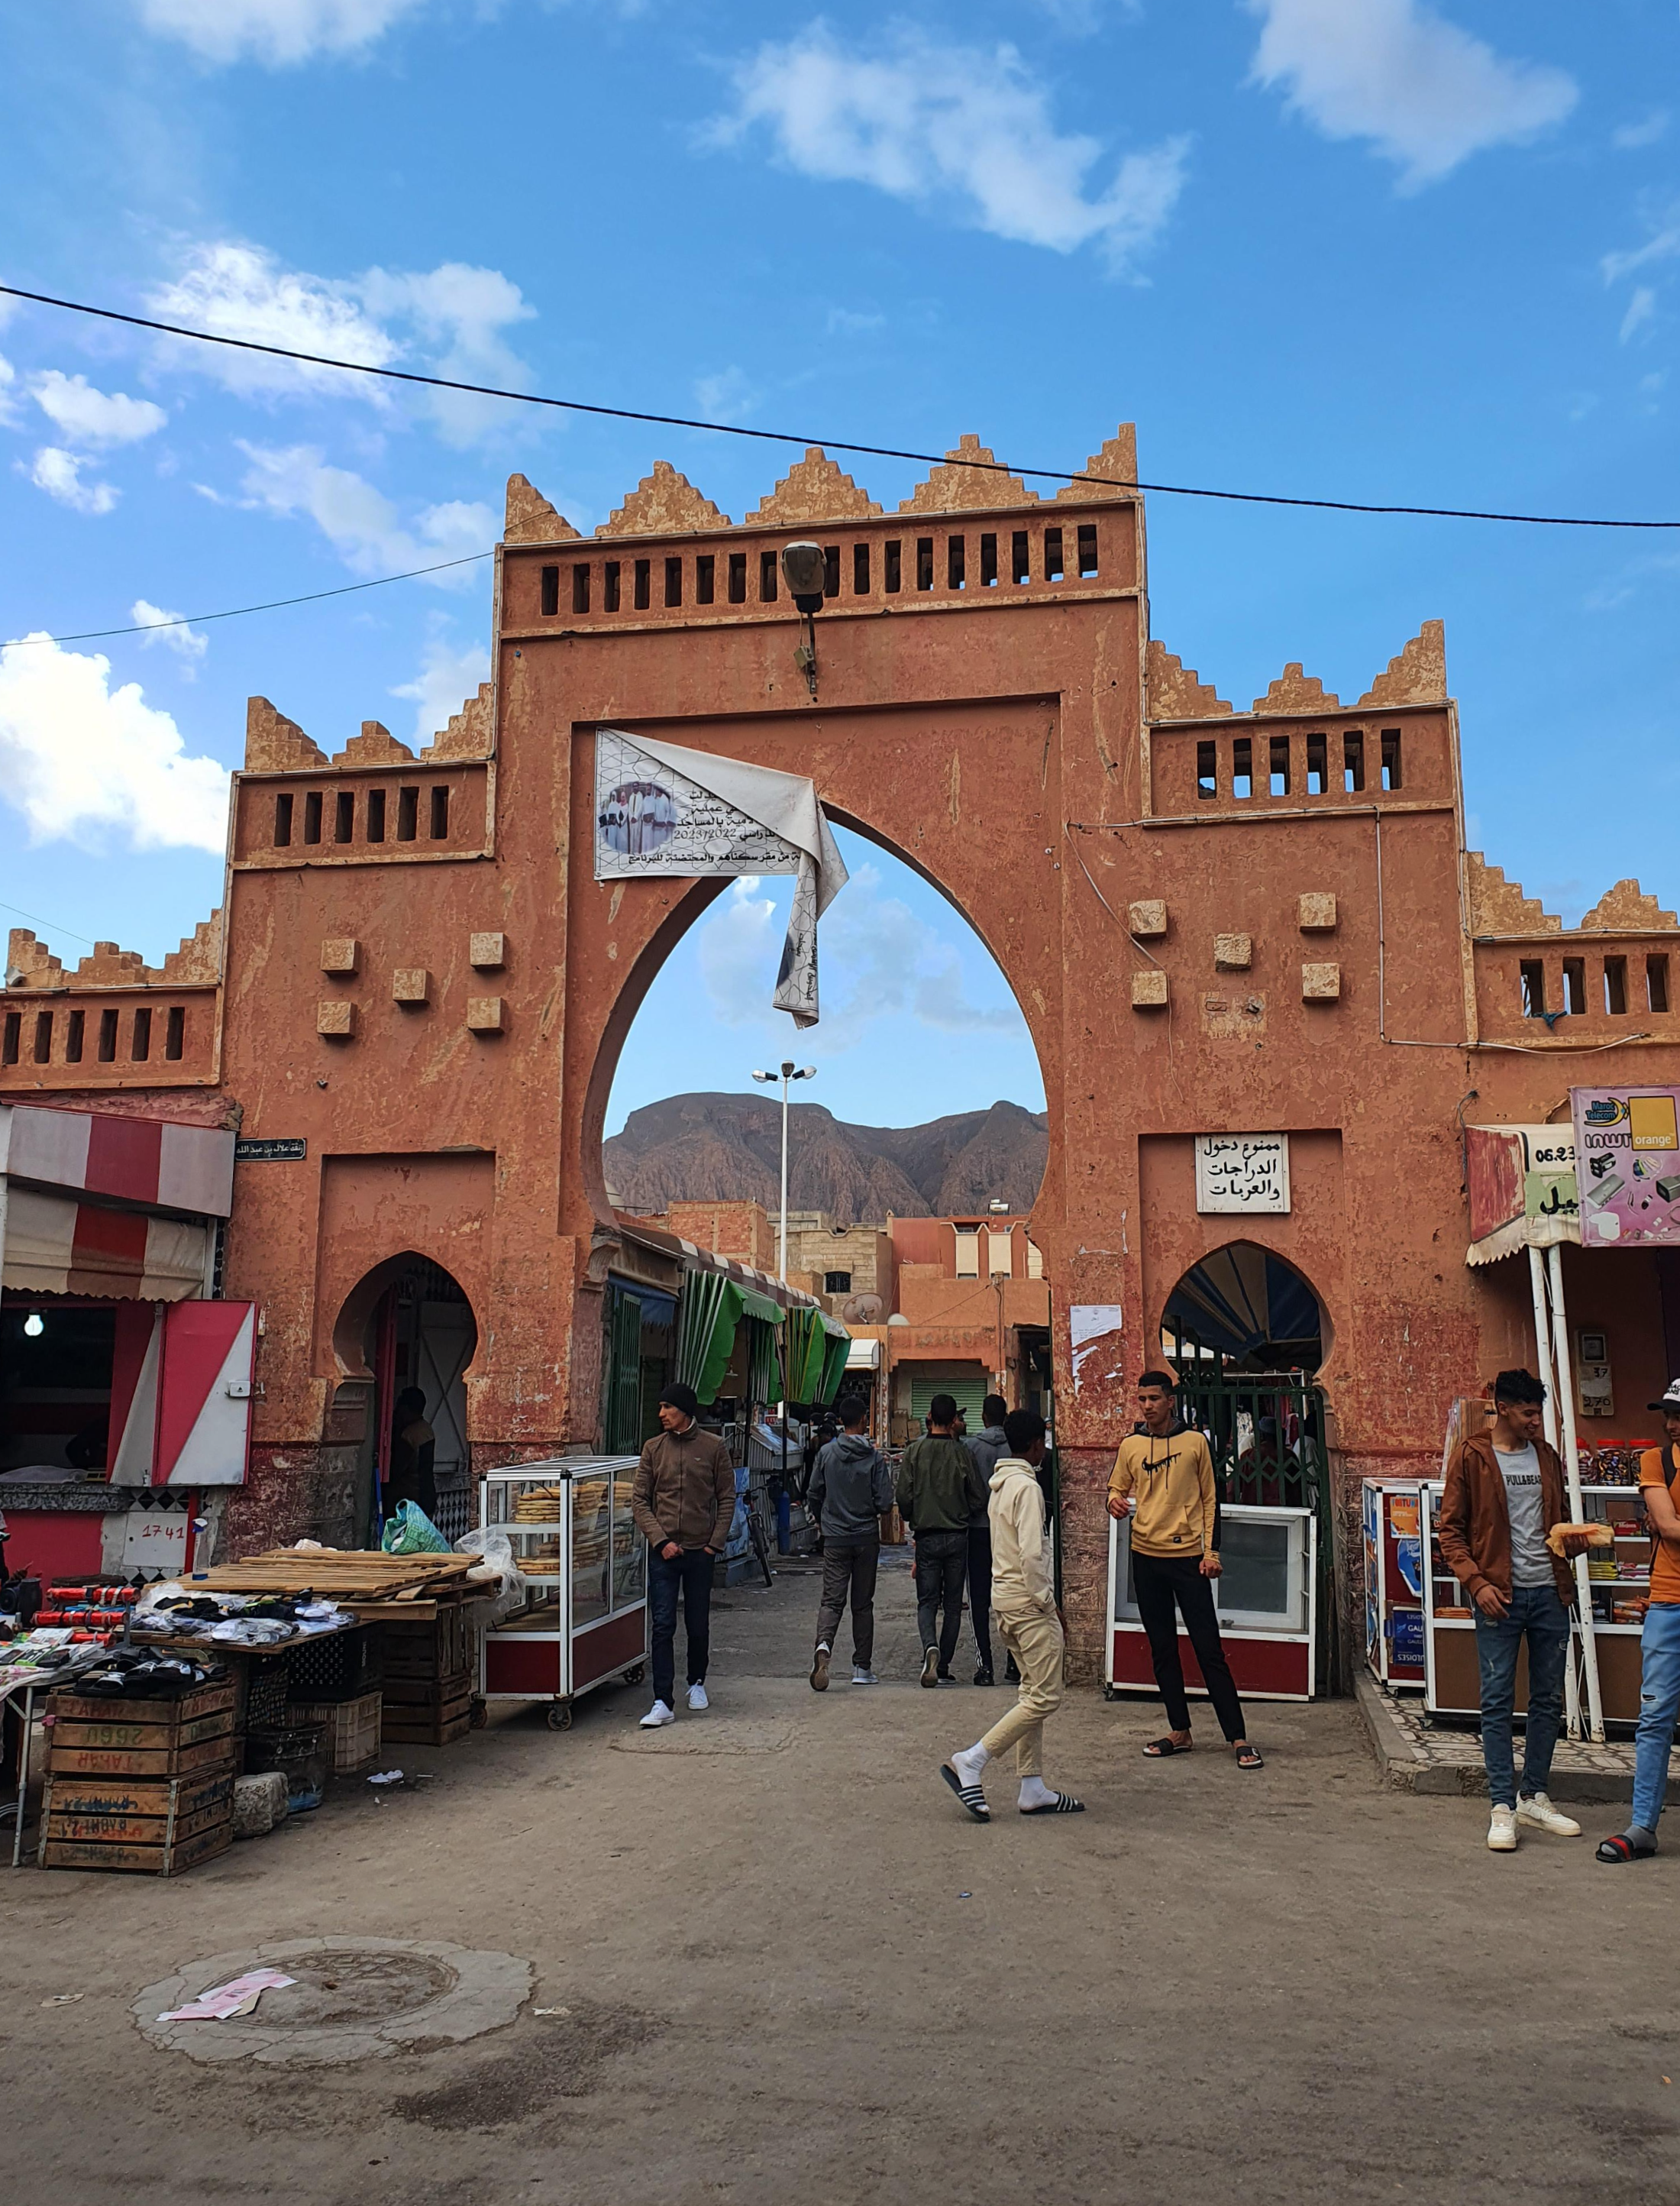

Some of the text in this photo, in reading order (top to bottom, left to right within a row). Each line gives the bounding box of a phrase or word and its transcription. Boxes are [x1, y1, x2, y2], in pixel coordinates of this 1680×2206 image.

[677, 817, 724, 829] بالمساجد
[777, 852, 790, 862] من
[1592, 1101, 1615, 1111] Maroc
[1585, 1111, 1616, 1120] Telecom
[1635, 1135, 1671, 1147] orange
[236, 1145, 249, 1153] الله
[250, 1146, 263, 1155] عبد
[1203, 1138, 1281, 1160] ممنوع دخول
[1207, 1159, 1277, 1182] الدراجات
[1209, 1179, 1280, 1201] والعربات
